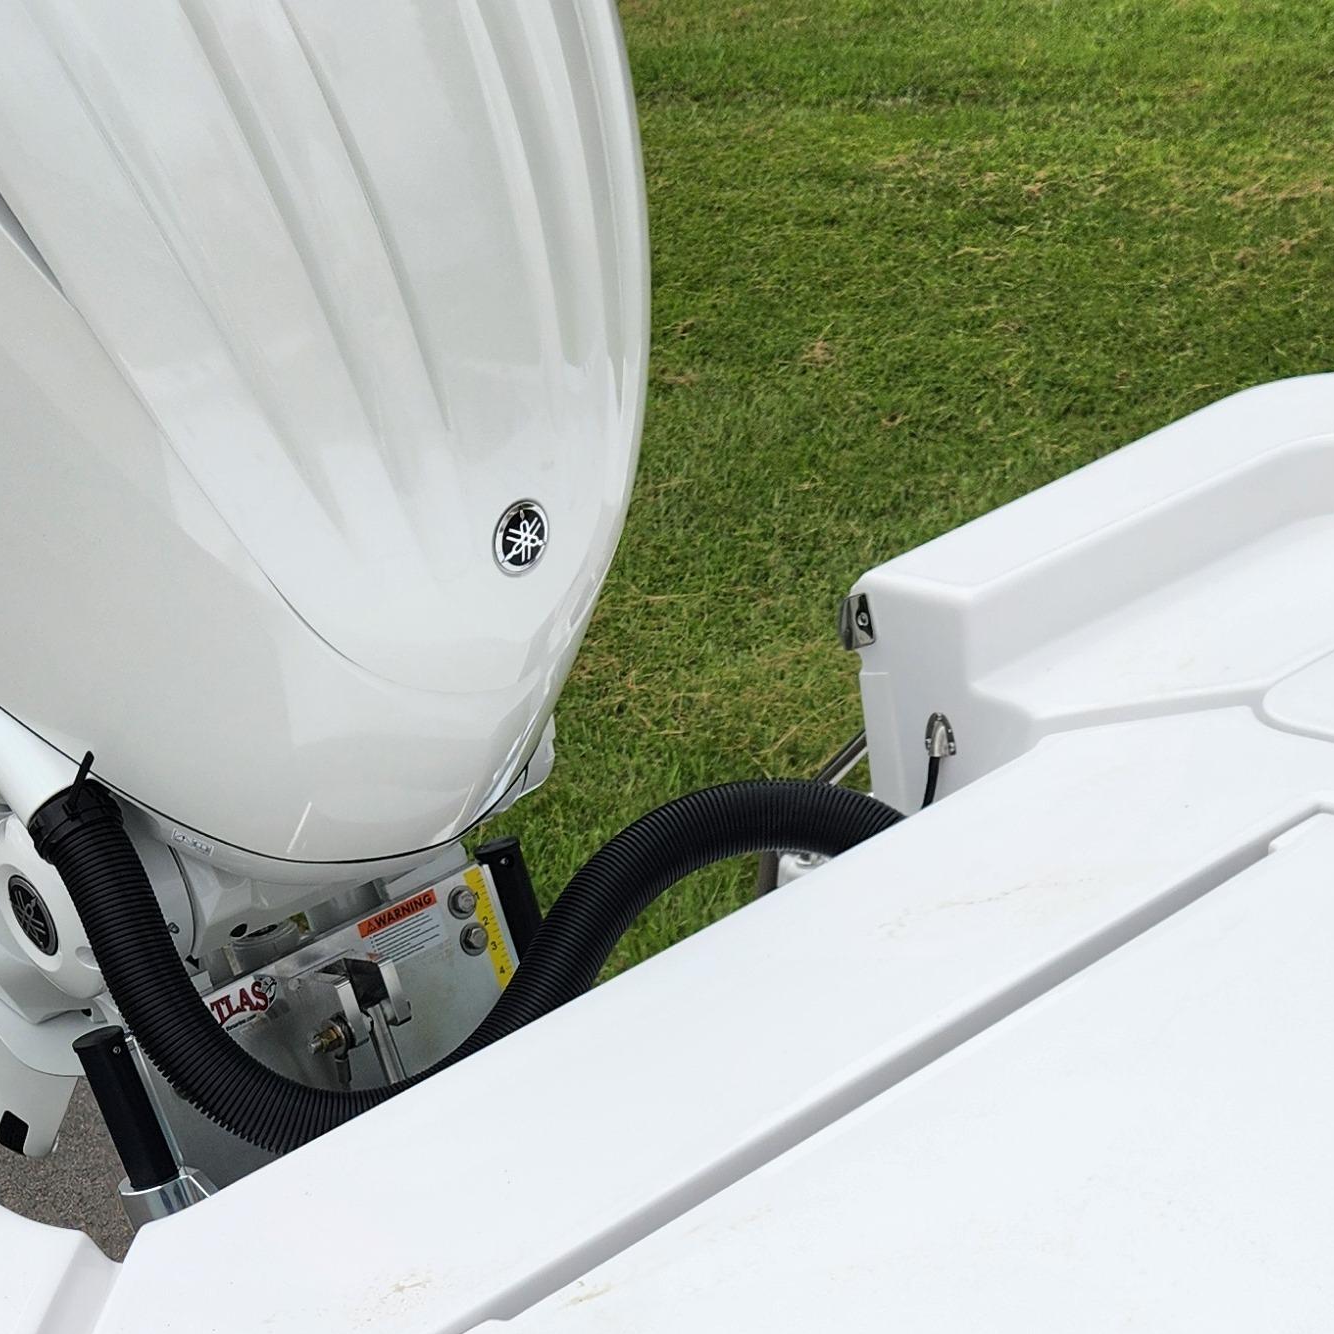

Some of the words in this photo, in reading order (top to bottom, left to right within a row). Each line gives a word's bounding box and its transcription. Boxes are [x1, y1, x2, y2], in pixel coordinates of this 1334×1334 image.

[374, 893, 432, 927] WARNING
[482, 916, 490, 926] 2
[490, 941, 498, 951] 3
[209, 980, 269, 1026] TLAS
